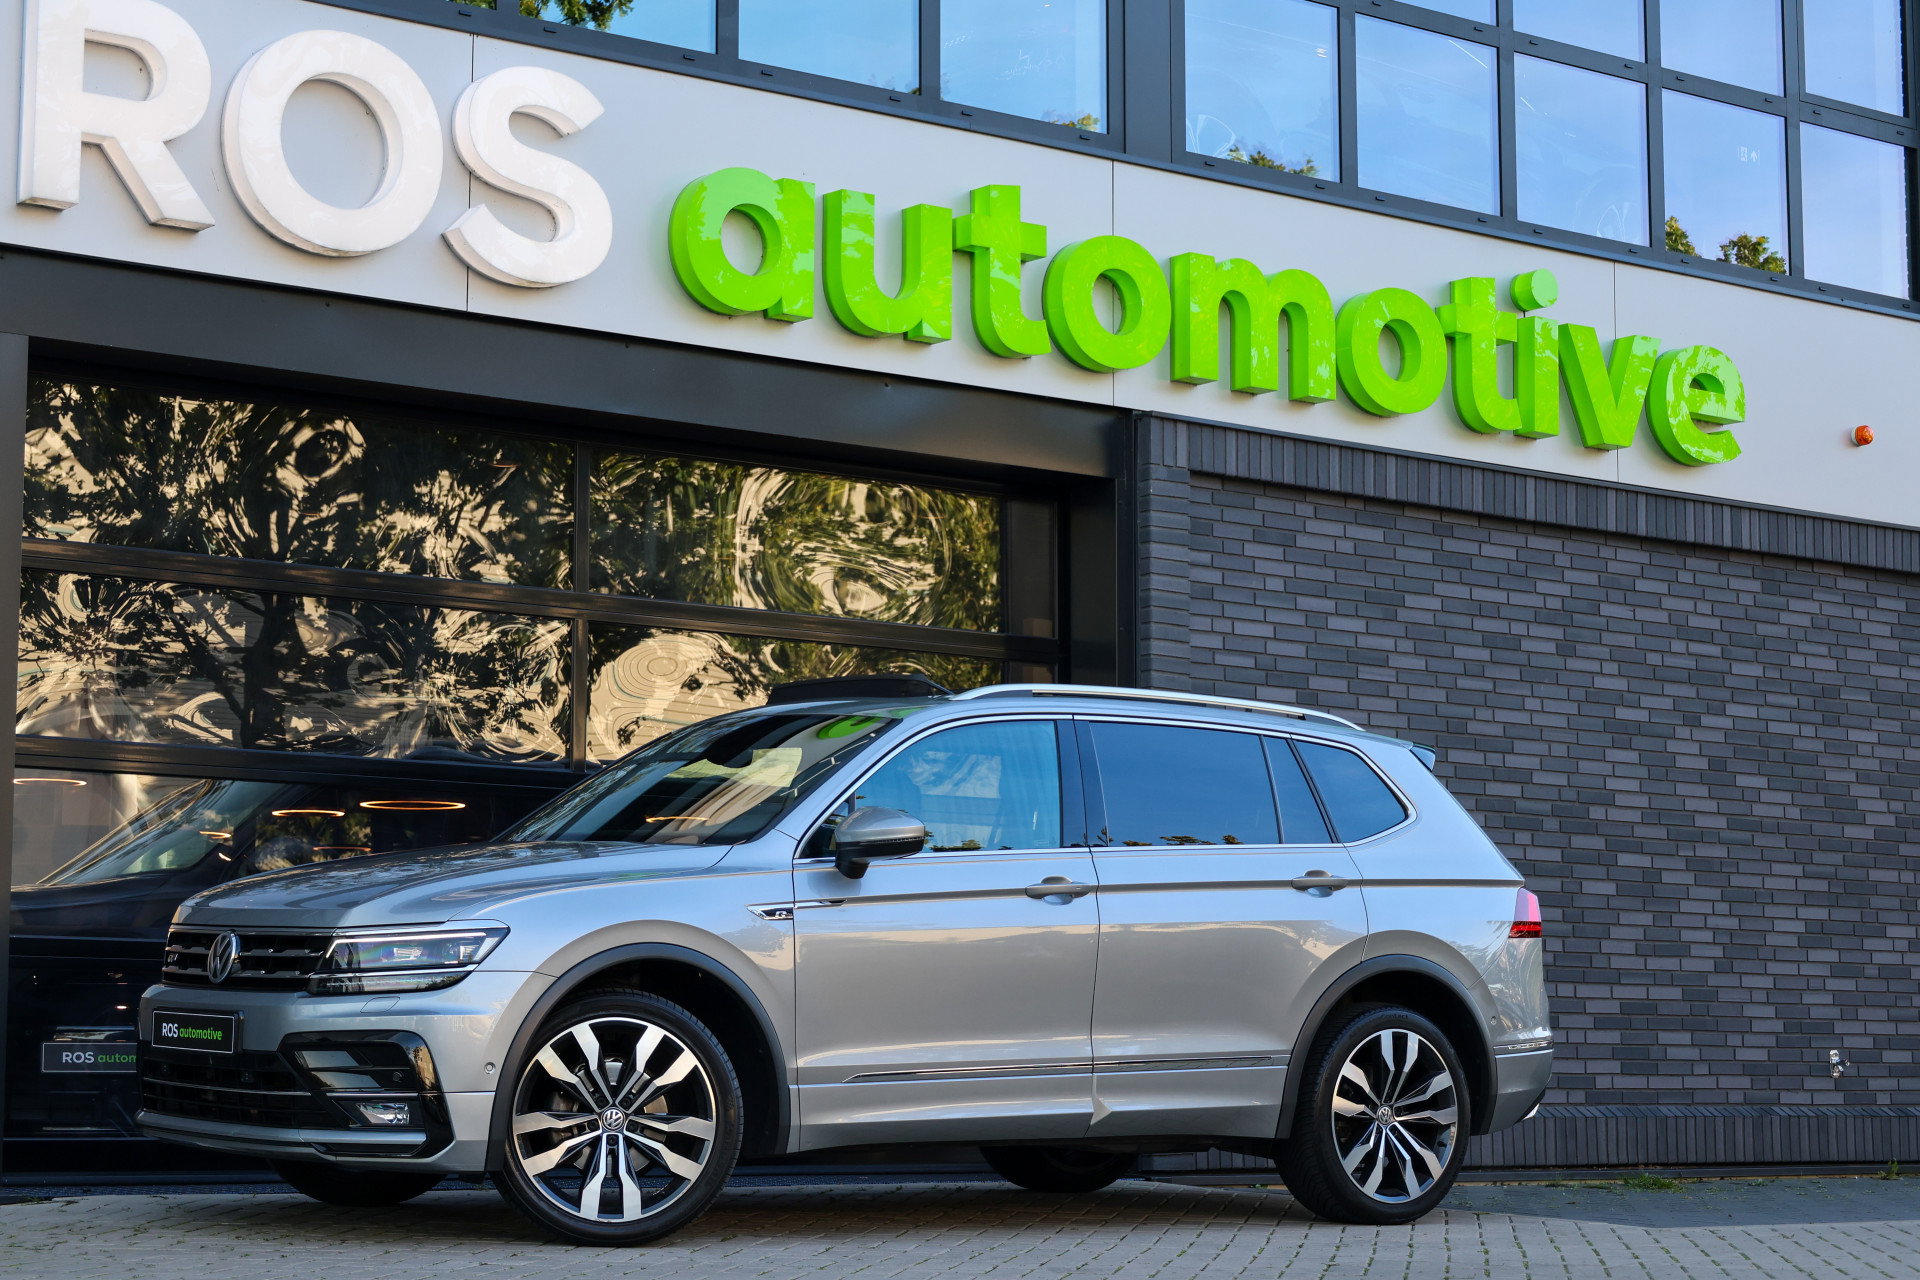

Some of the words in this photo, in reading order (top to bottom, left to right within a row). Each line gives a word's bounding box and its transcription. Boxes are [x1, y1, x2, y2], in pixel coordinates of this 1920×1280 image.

[17, 0, 613, 289] ROS
[668, 167, 1746, 466] automotive
[162, 1023, 178, 1037] ROS
[179, 1027, 223, 1040] automotive
[62, 1052, 95, 1064] ROS
